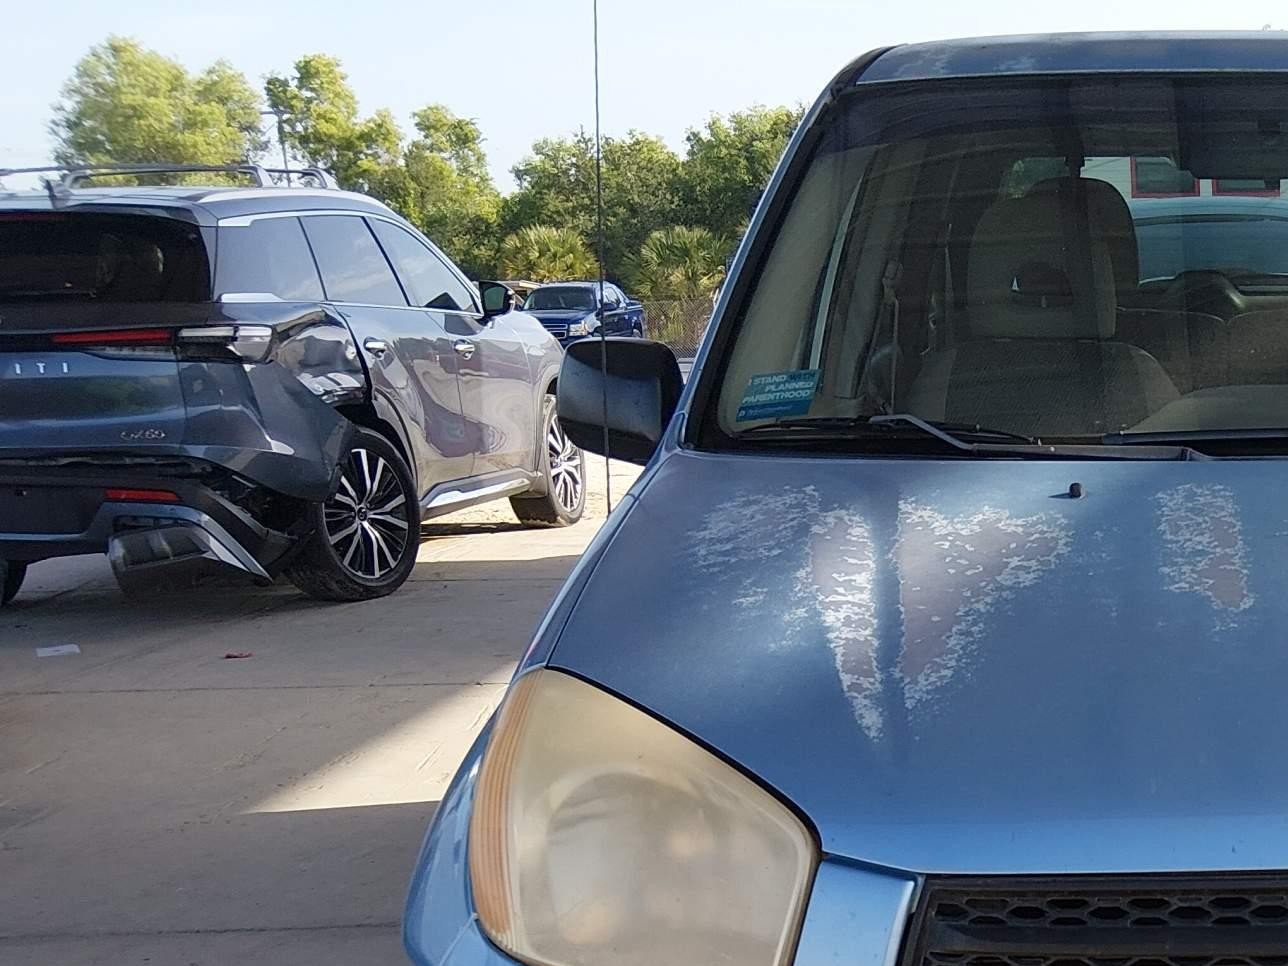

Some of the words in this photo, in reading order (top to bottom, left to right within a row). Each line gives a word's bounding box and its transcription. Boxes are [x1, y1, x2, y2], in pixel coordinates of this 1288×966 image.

[753, 375, 788, 385] STAND
[765, 382, 814, 392] PLANNED
[742, 390, 810, 403] PARENTHOOD
